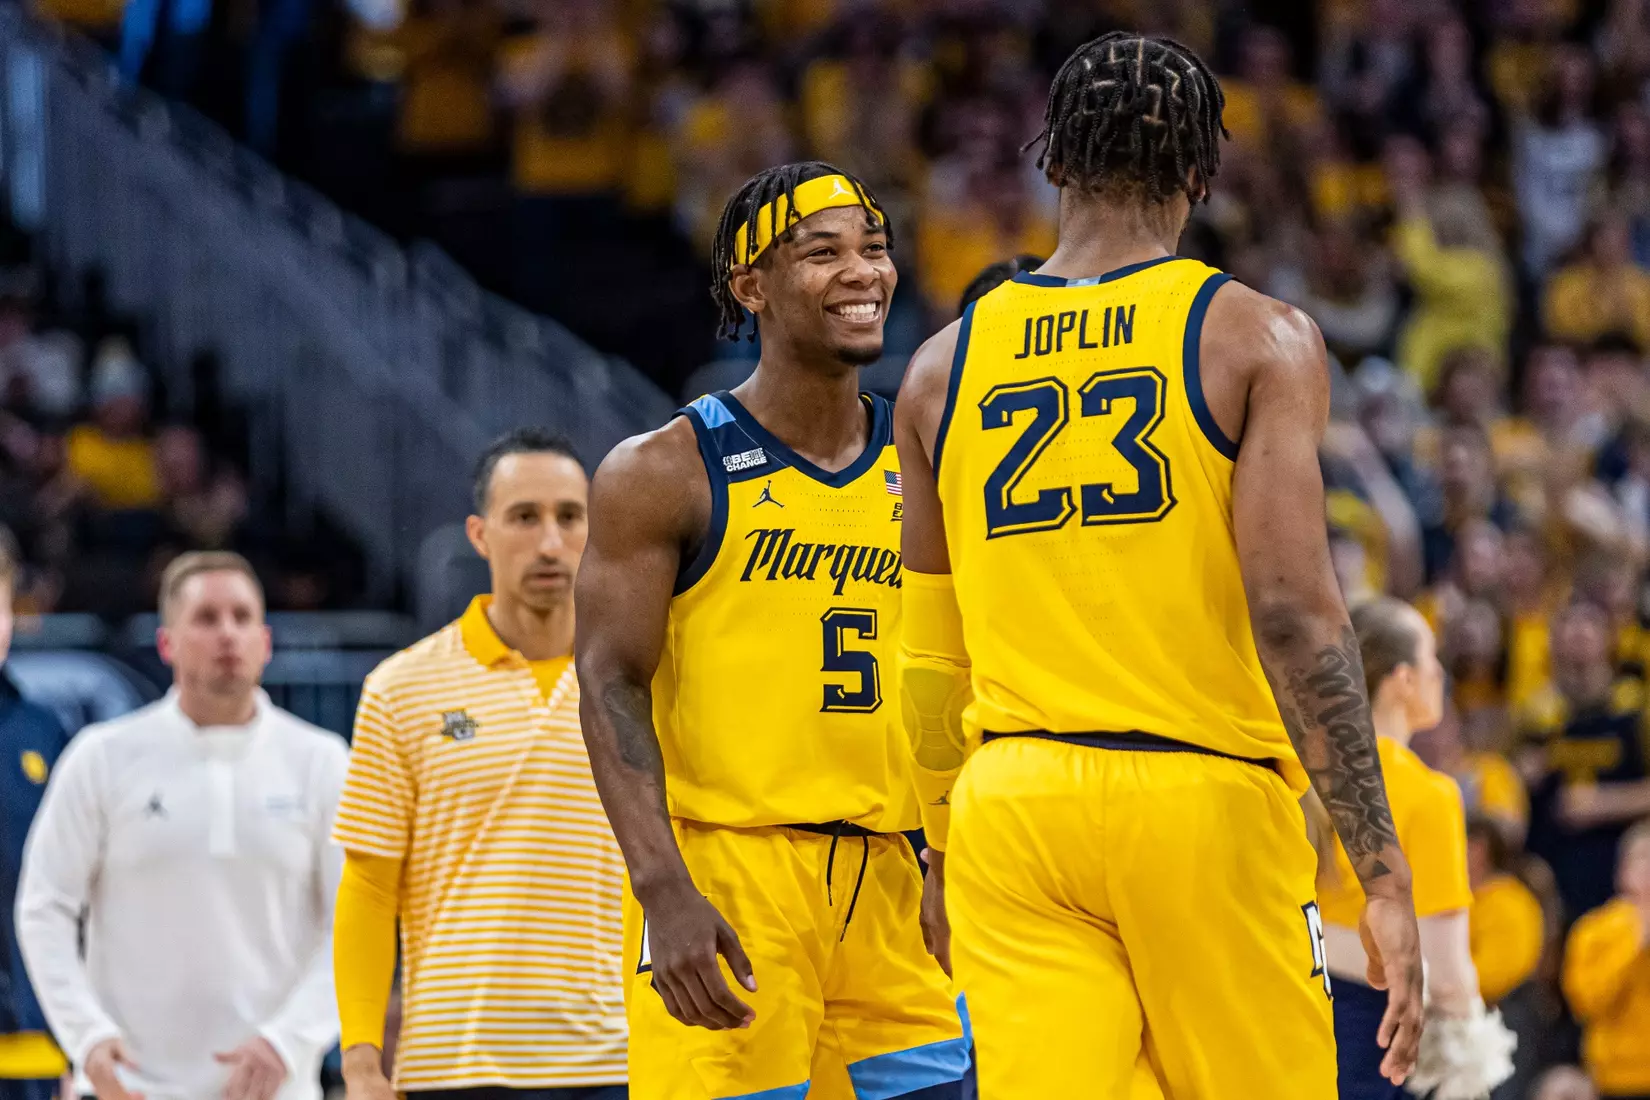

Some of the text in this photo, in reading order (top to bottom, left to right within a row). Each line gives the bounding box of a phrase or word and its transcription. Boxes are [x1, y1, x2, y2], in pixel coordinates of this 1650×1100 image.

[1014, 304, 1137, 359] JOPLIN
[726, 456, 767, 472] CHANGE
[731, 451, 751, 464] BE
[978, 366, 1178, 540] 23
[819, 607, 883, 714] 5
